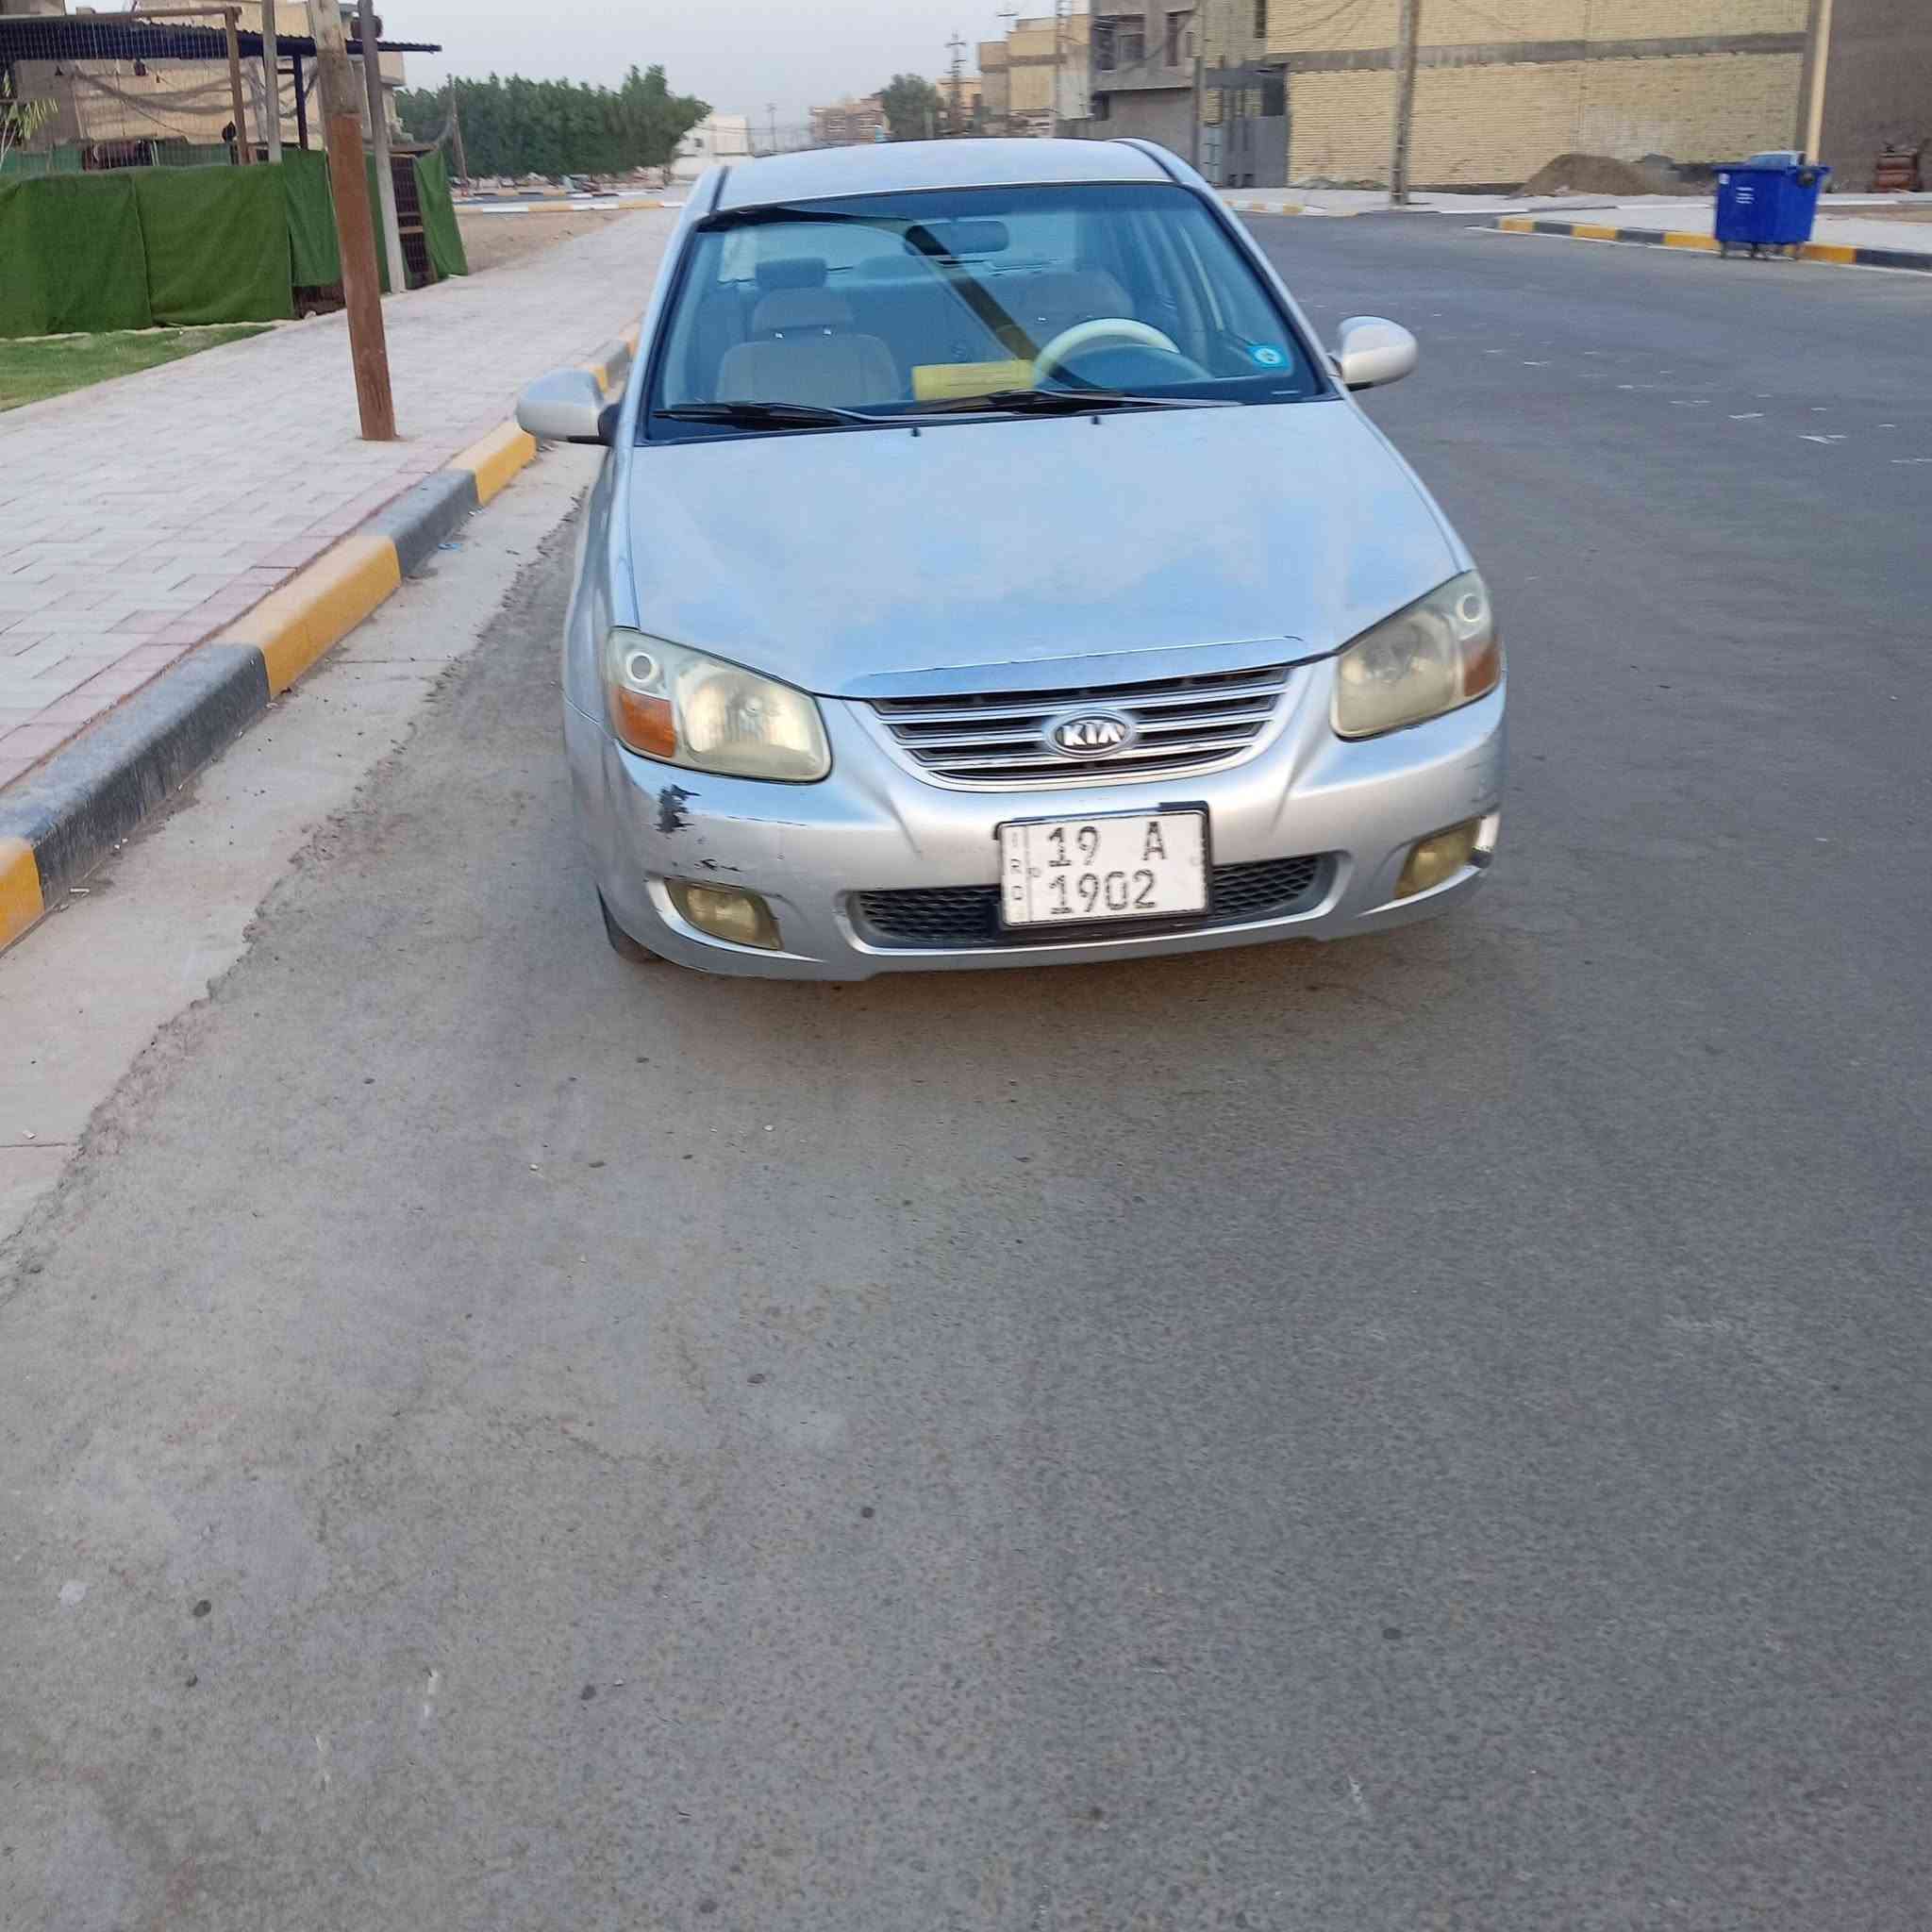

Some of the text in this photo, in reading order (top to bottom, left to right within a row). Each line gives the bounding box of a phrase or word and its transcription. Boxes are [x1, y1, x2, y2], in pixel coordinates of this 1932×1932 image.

[1063, 720, 1122, 746] KIA
[1048, 821, 1168, 867] 19 A
[1048, 870, 1157, 915] 1902
